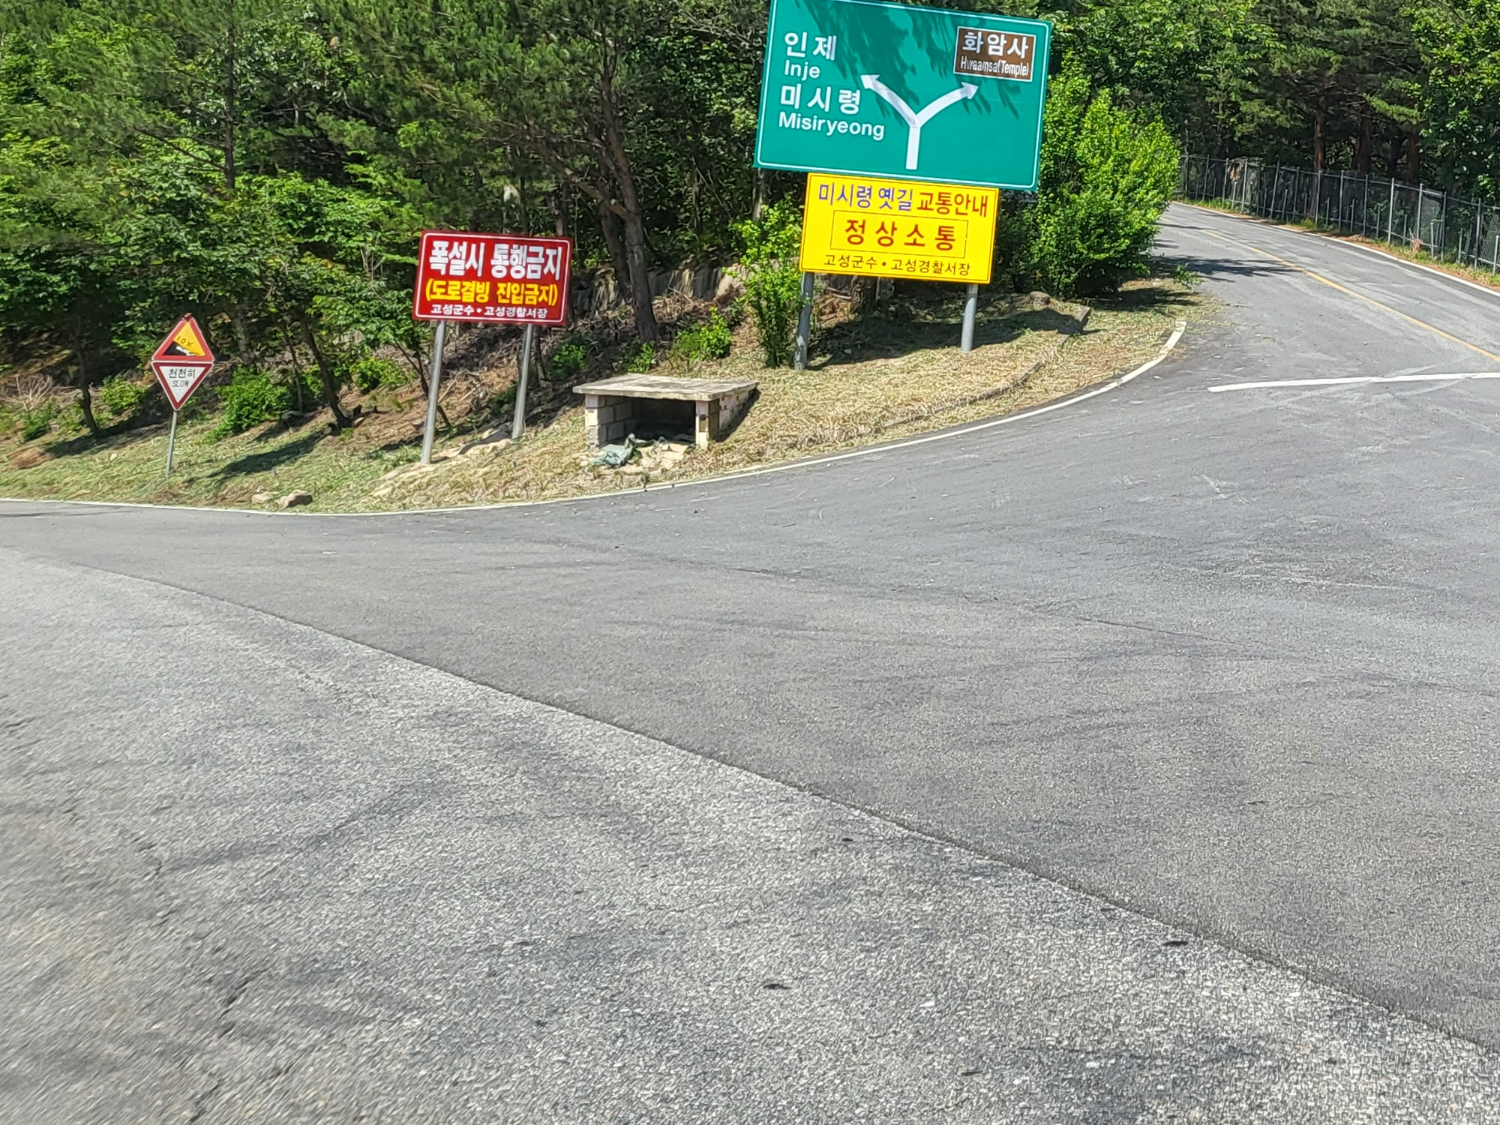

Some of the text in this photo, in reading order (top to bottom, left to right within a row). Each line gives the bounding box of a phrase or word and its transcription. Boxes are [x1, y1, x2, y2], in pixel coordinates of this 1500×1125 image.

[783, 31, 838, 61] 인제
[962, 31, 1029, 59] 화암사
[784, 60, 821, 79] Inje
[780, 83, 861, 115] 미시령
[778, 111, 885, 141] Misiryeong
[818, 182, 873, 209] 미시령
[916, 191, 989, 218] 교통안내
[428, 240, 563, 281] 폭설시 통행금지
[425, 278, 559, 307] (도로결빙 진입금지)
[176, 335, 194, 348] 10%
[168, 368, 196, 379] 천천히
[172, 379, 190, 388] SLOW
